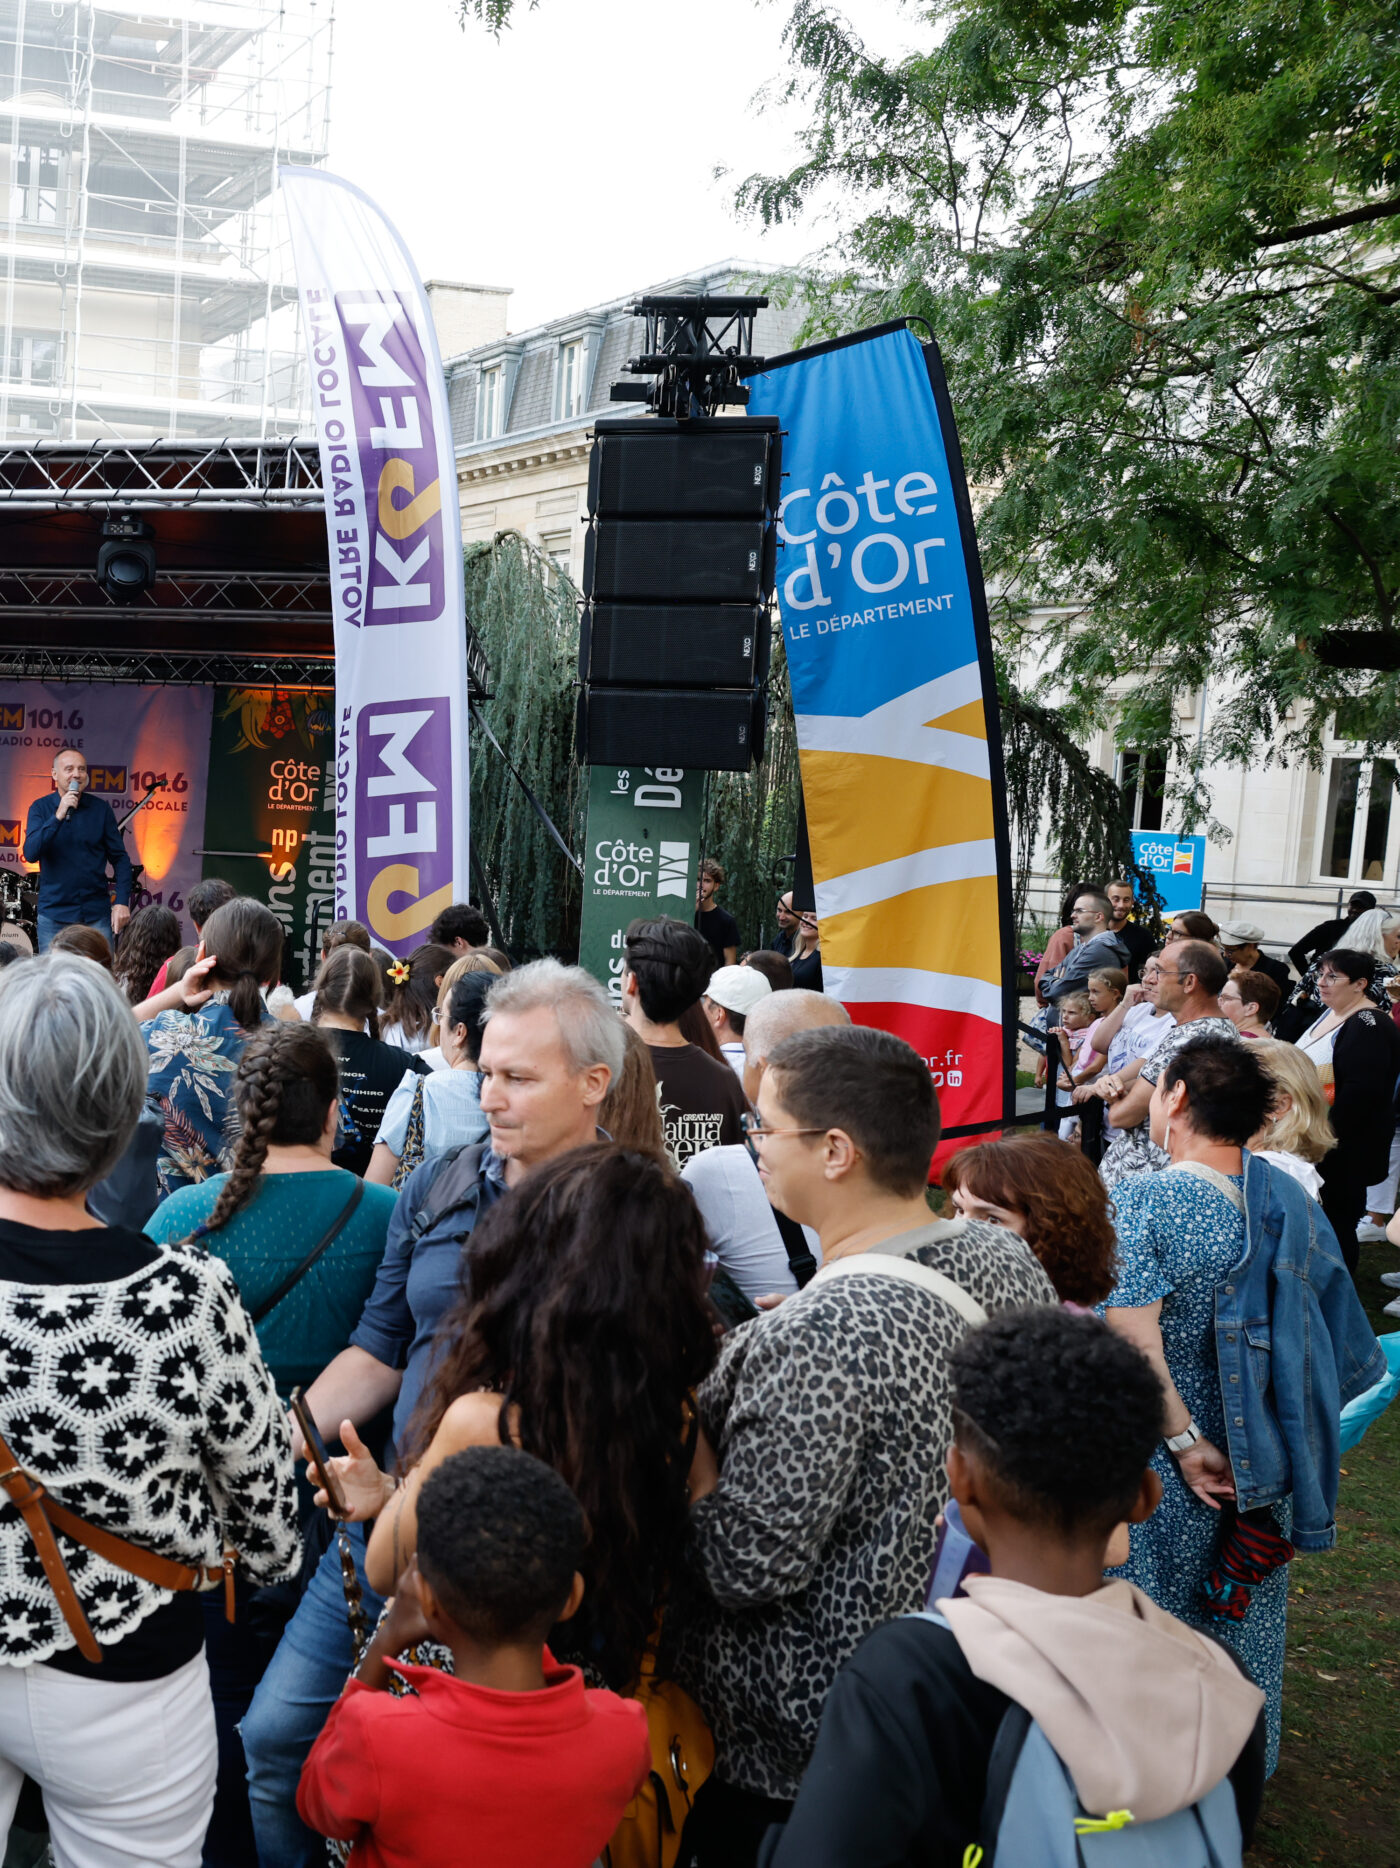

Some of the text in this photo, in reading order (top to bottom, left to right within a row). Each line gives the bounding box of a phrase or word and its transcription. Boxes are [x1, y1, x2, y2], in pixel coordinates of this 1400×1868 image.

[754, 465, 762, 486] NEXO
[776, 470, 939, 546] Côte
[748, 551, 757, 571] NEXO
[783, 532, 946, 612] d'Or
[789, 593, 954, 641] LE DÉPARTEMENT
[743, 637, 751, 657] NEXO
[27, 708, 84, 730] 101.6
[36, 737, 84, 749] LOCALE
[270, 758, 321, 781] Côte
[268, 778, 320, 803] d'Or
[610, 769, 630, 795] les
[276, 802, 319, 812] DÉPARTEMENT
[595, 838, 654, 864] Côte
[1139, 842, 1173, 856] Côte
[1138, 853, 1172, 868] d'Or
[594, 862, 652, 888] d'Or
[592, 888, 651, 898] LE DÉPARTEMENT
[342, 1087, 385, 1097] CHIHIRO
[682, 1113, 705, 1122] GREAT
